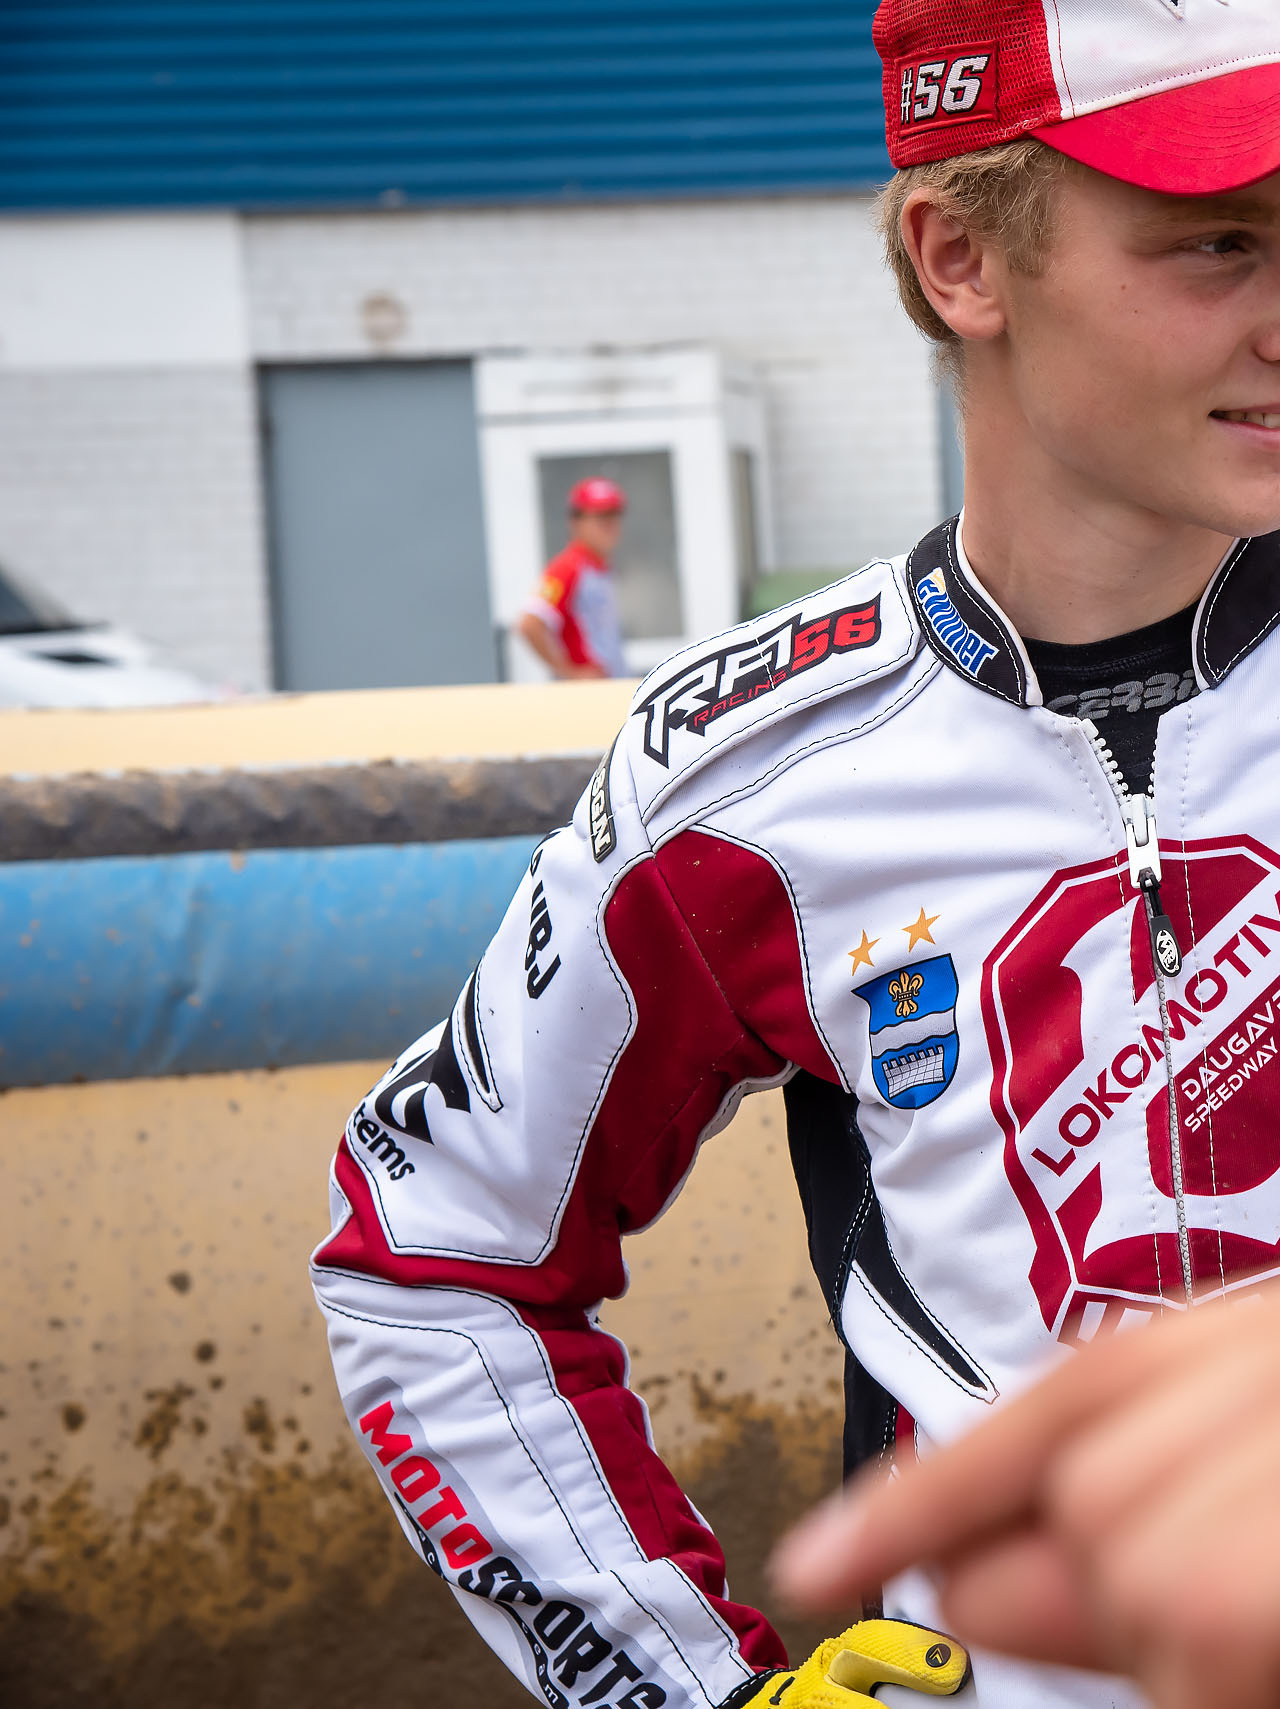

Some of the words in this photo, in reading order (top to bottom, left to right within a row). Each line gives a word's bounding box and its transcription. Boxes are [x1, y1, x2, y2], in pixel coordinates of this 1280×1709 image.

[901, 53, 990, 123] #56
[694, 671, 787, 727] RACING
[1184, 1043, 1279, 1133] SPEEDWAY
